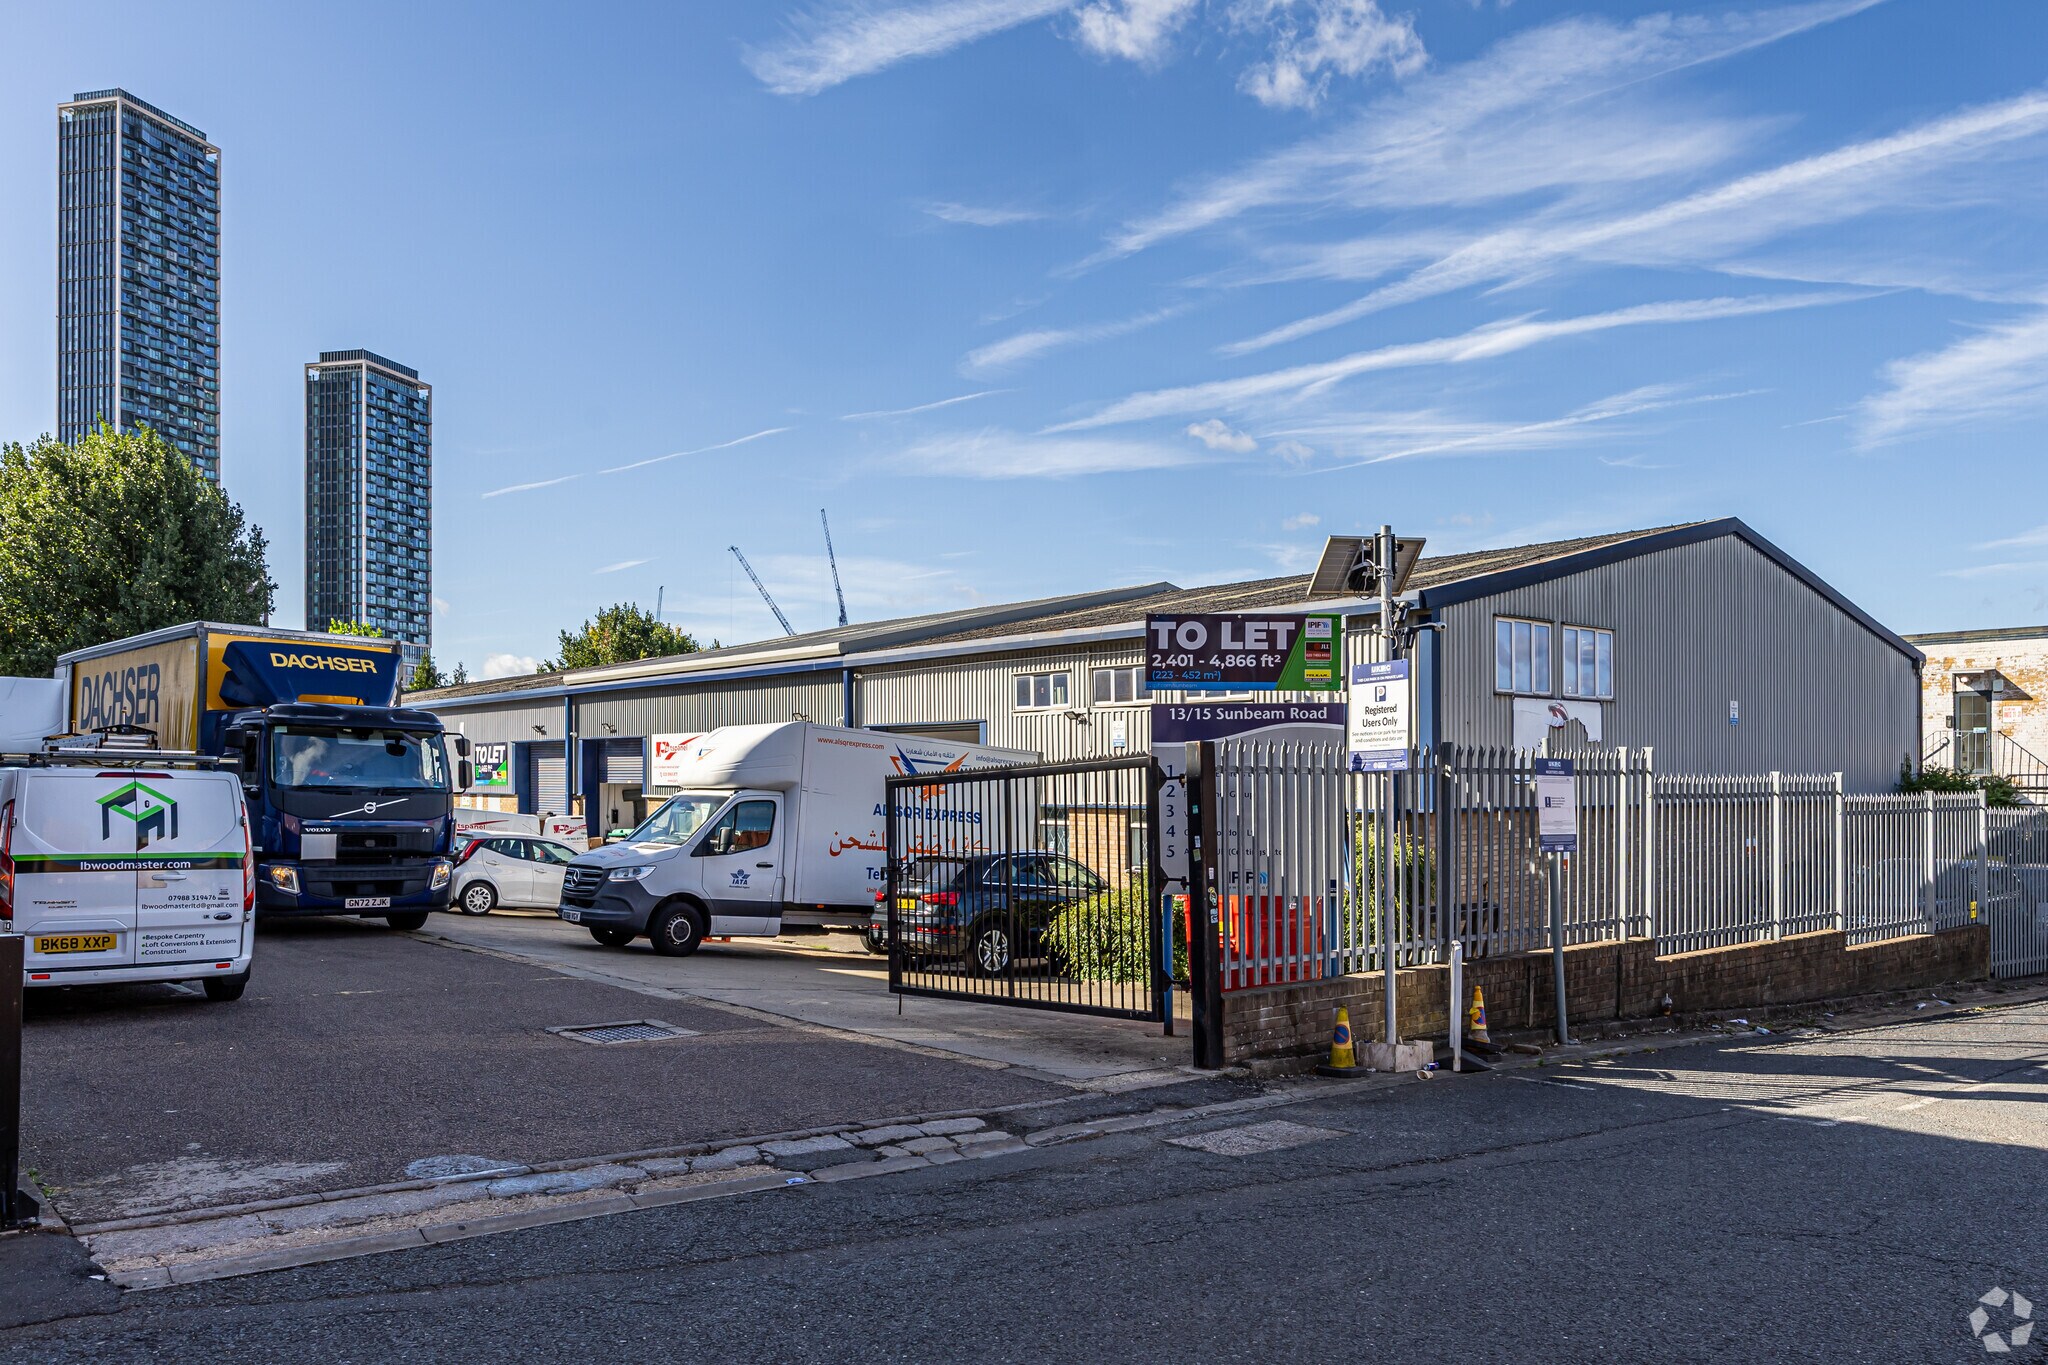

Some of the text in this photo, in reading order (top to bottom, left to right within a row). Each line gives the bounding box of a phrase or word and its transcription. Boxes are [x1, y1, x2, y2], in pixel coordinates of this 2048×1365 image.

[1151, 621, 1295, 650] TO LET
[270, 652, 378, 674] DACHSER
[1152, 654, 1194, 669] 2,401
[1209, 654, 1256, 669] 4,866
[1152, 670, 1174, 681] (223
[1182, 670, 1201, 680] 452
[80, 663, 161, 730] DACHSER
[1169, 707, 1328, 721] 13/15 Sunbeam Road
[1365, 703, 1397, 716] Registered
[1362, 716, 1398, 728] Users Only
[817, 737, 885, 749] www.alsqrexpress.com
[476, 746, 505, 763] TO LET
[1167, 765, 1173, 777] 1
[1166, 785, 1175, 797] 2
[895, 806, 921, 819] SQR
[925, 808, 982, 824] EXPRESS
[1166, 805, 1174, 817] 3
[1166, 825, 1175, 837] 4
[1166, 845, 1175, 857] 5
[80, 861, 191, 871] lbwoodmaster.com
[866, 867, 881, 880] Te
[349, 898, 387, 907] GN72 ZJK
[41, 936, 111, 950] BK68 XXP
